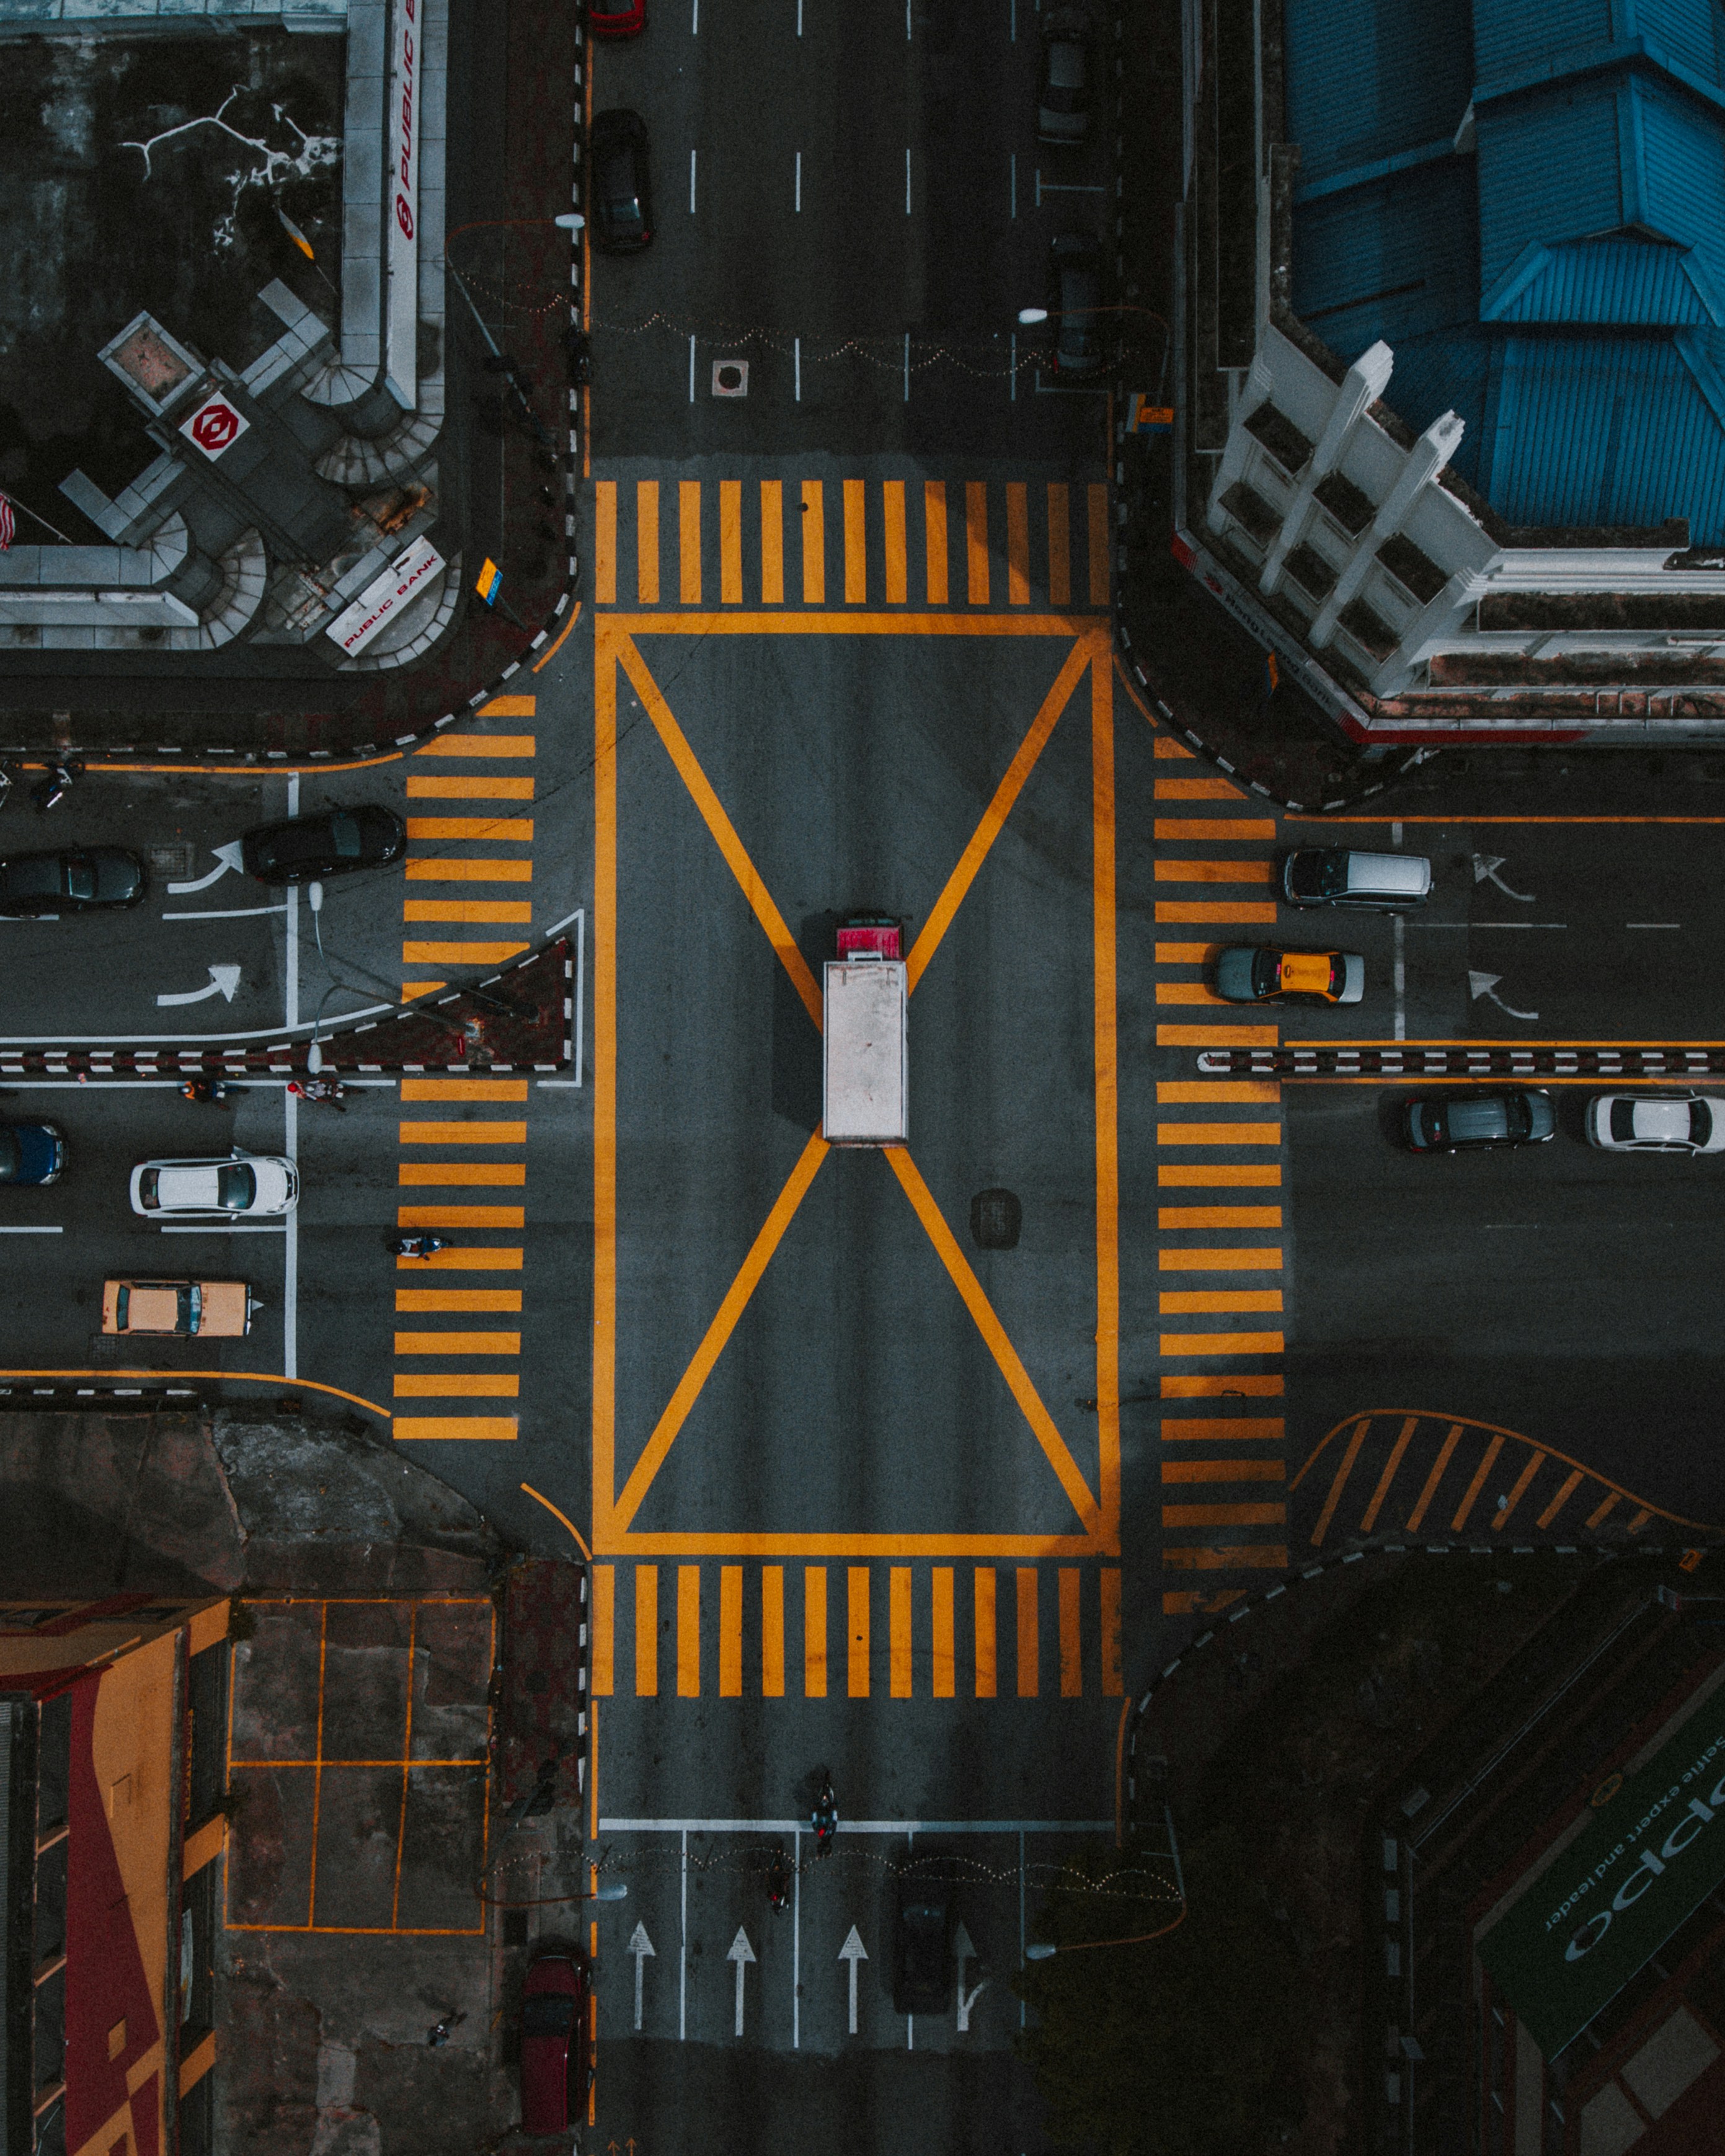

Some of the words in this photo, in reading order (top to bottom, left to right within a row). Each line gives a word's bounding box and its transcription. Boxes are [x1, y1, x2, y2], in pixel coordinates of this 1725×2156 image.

[401, 30, 414, 190] PUBLIC
[344, 599, 394, 648] PUBLIC
[397, 555, 437, 595] BANK
[1626, 1785, 1680, 1843] expert
[1594, 1843, 1625, 1879] and
[1545, 1876, 1597, 1932] leader
